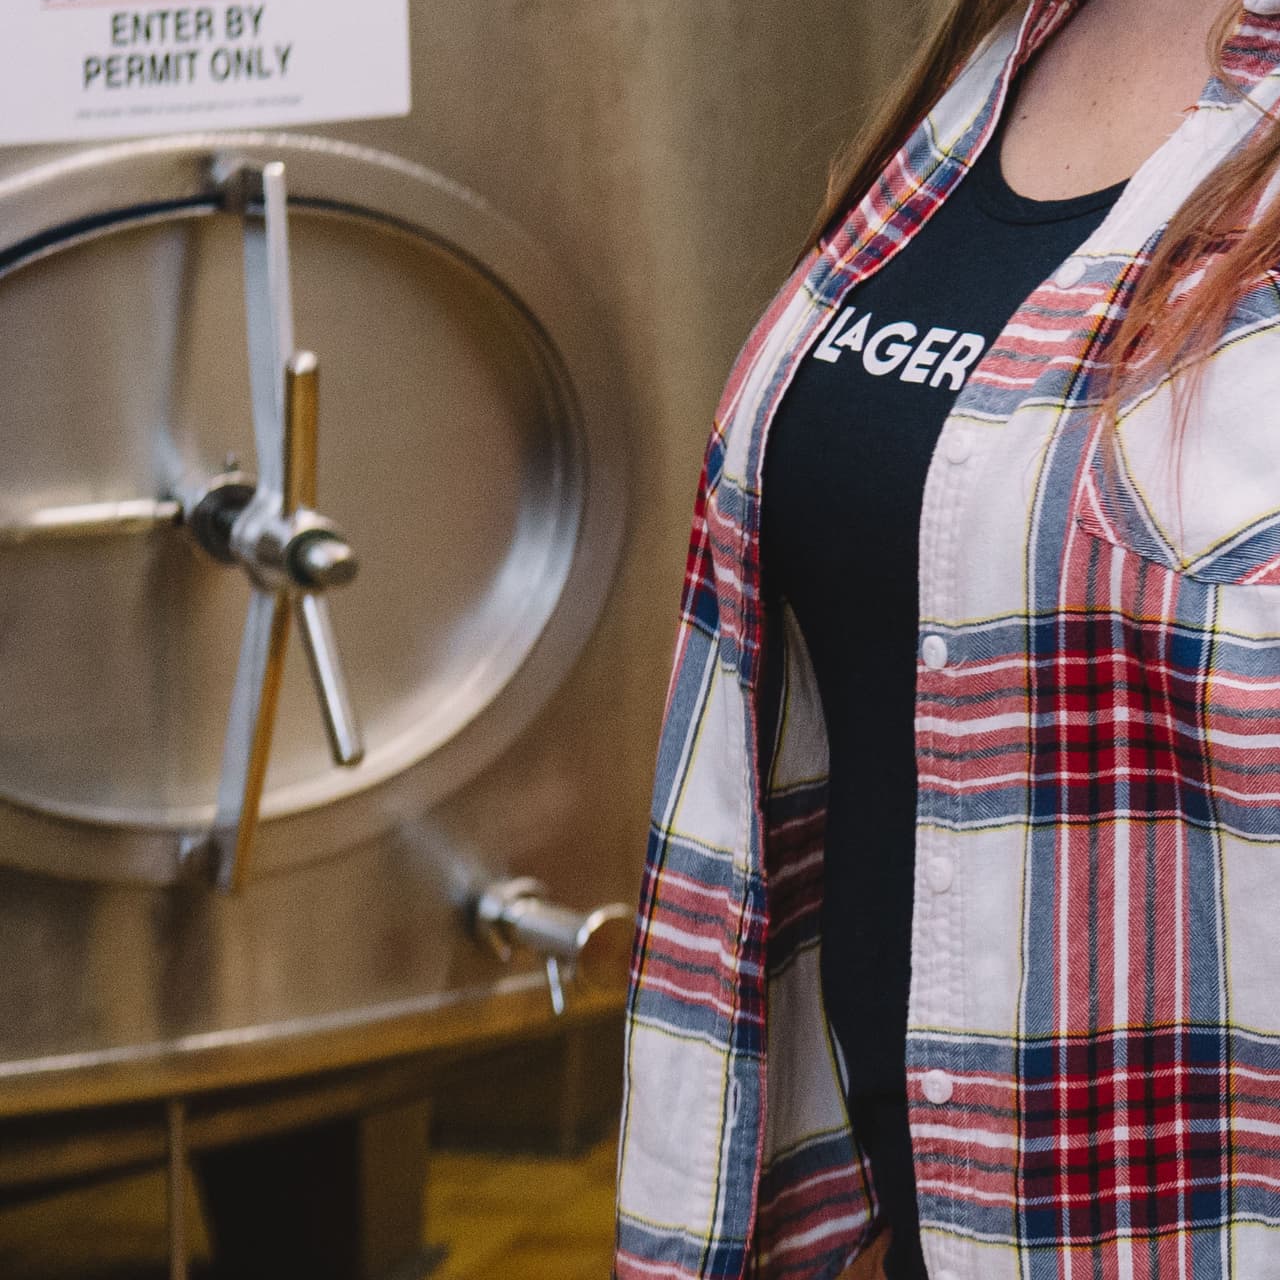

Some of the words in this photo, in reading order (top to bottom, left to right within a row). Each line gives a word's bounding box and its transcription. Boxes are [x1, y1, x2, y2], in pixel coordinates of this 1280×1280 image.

[111, 6, 214, 47] ENTER
[225, 4, 265, 39] BY
[82, 51, 201, 91] PERMIT
[210, 43, 293, 83] ONLY
[812, 306, 985, 391] LAGER
